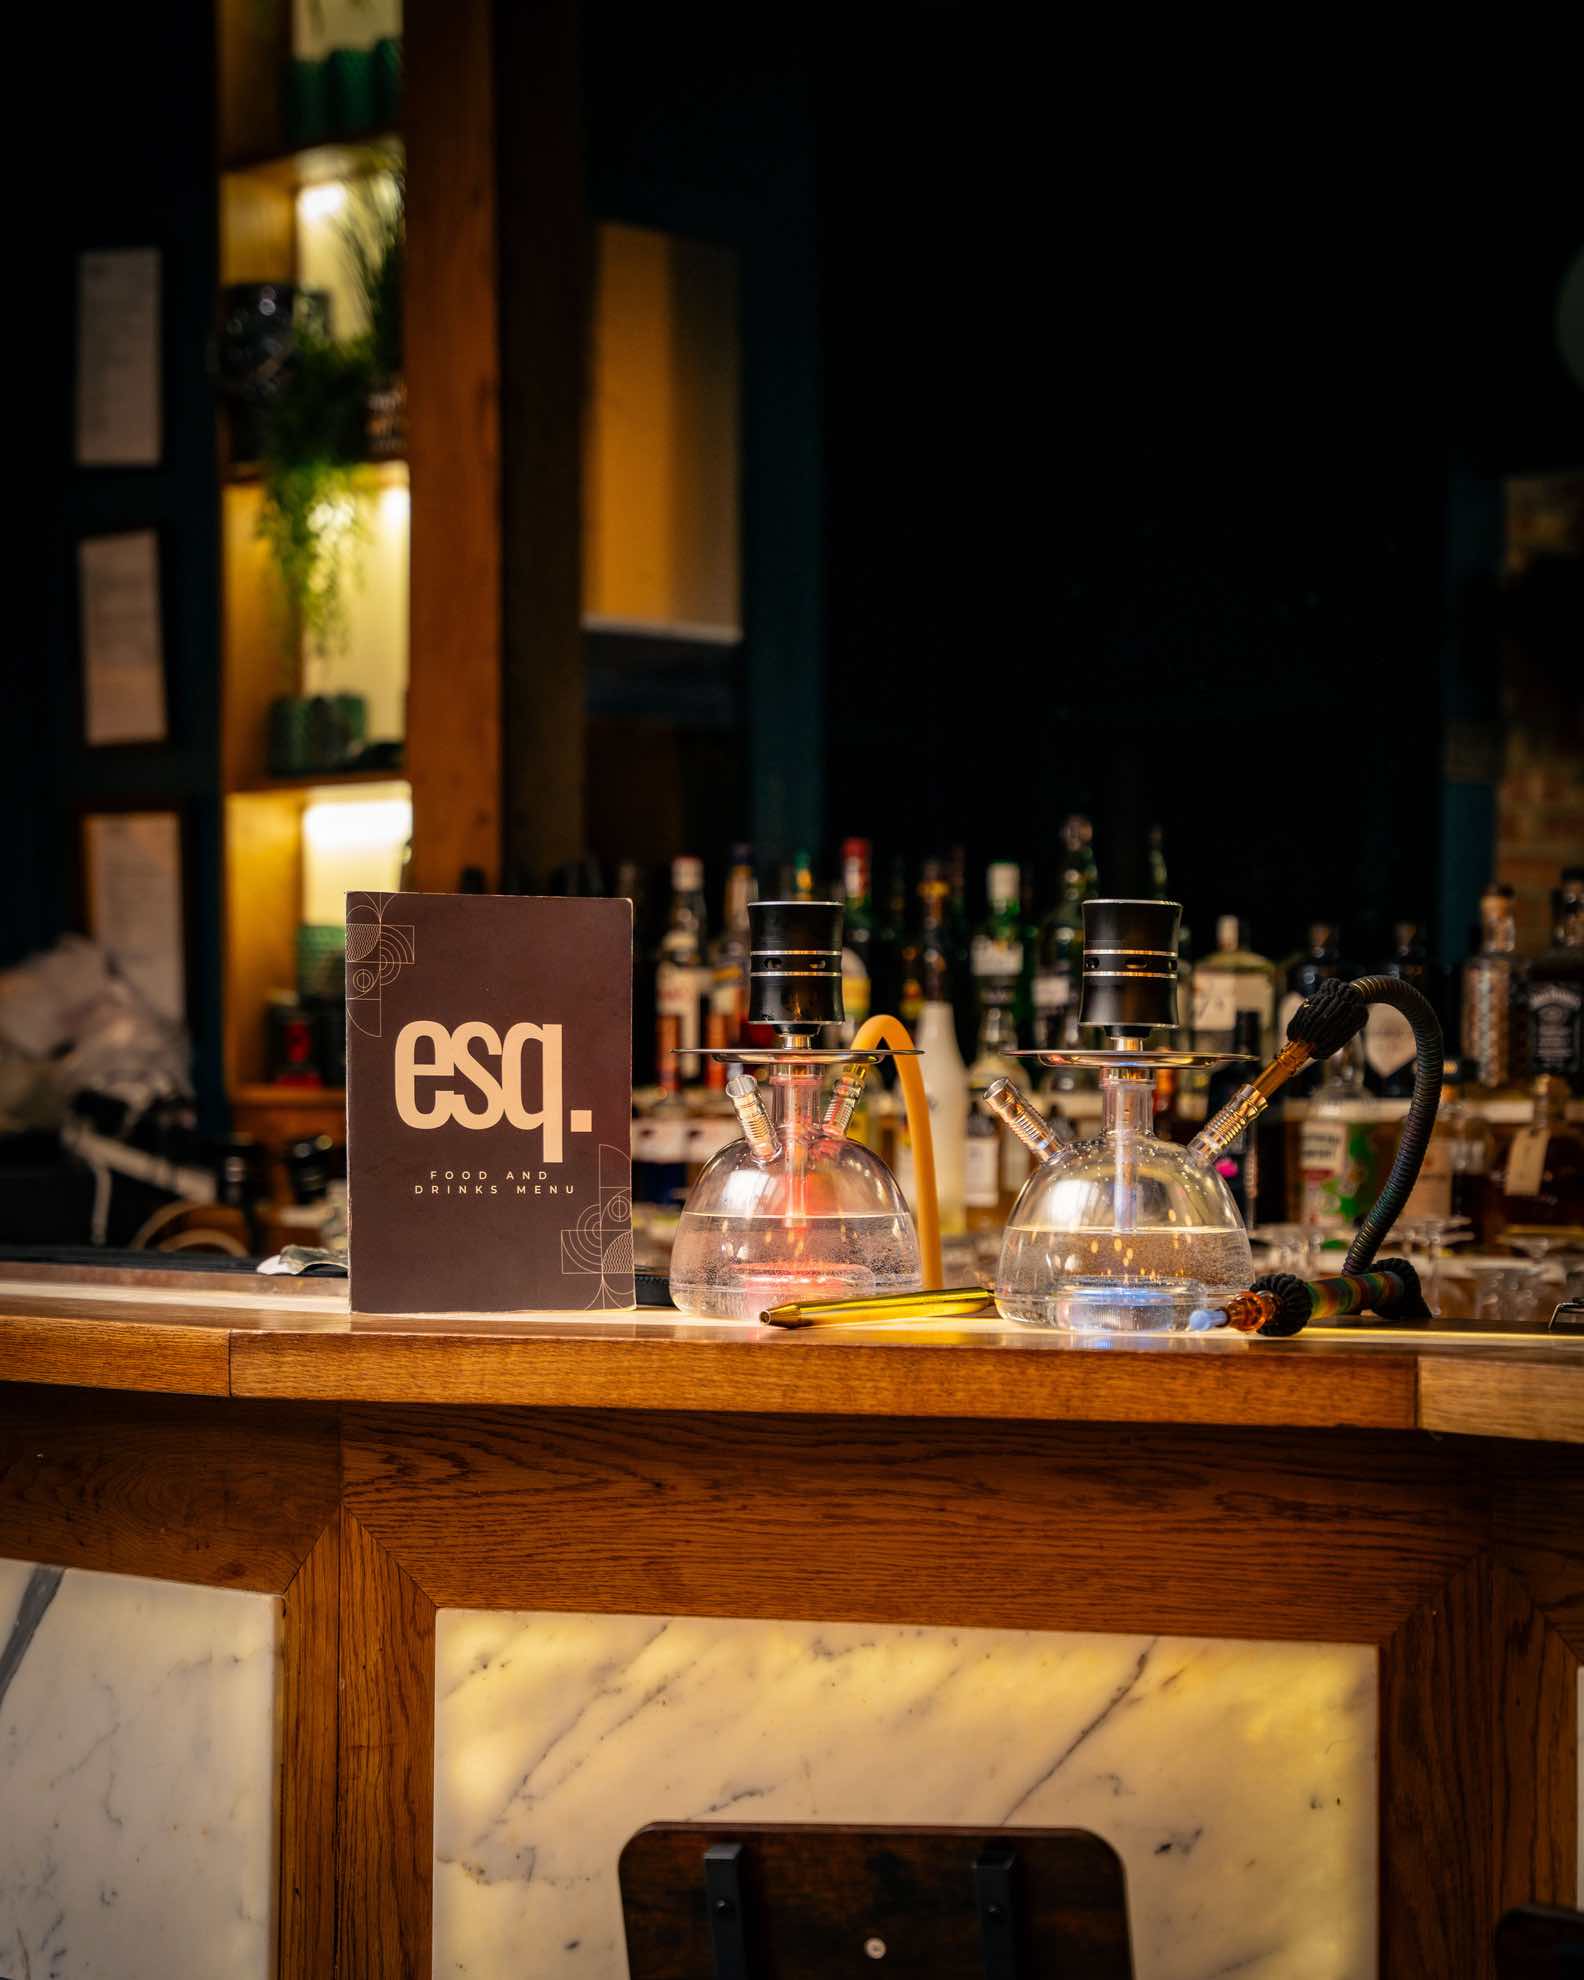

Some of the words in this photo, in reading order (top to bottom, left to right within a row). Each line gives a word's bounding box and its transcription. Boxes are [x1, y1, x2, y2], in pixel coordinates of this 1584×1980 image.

[395, 1020, 592, 1163] esq.
[430, 1170, 488, 1181] FOOD
[505, 1170, 549, 1181] AND
[414, 1184, 499, 1195] DRINKS
[516, 1184, 575, 1195] MENU
